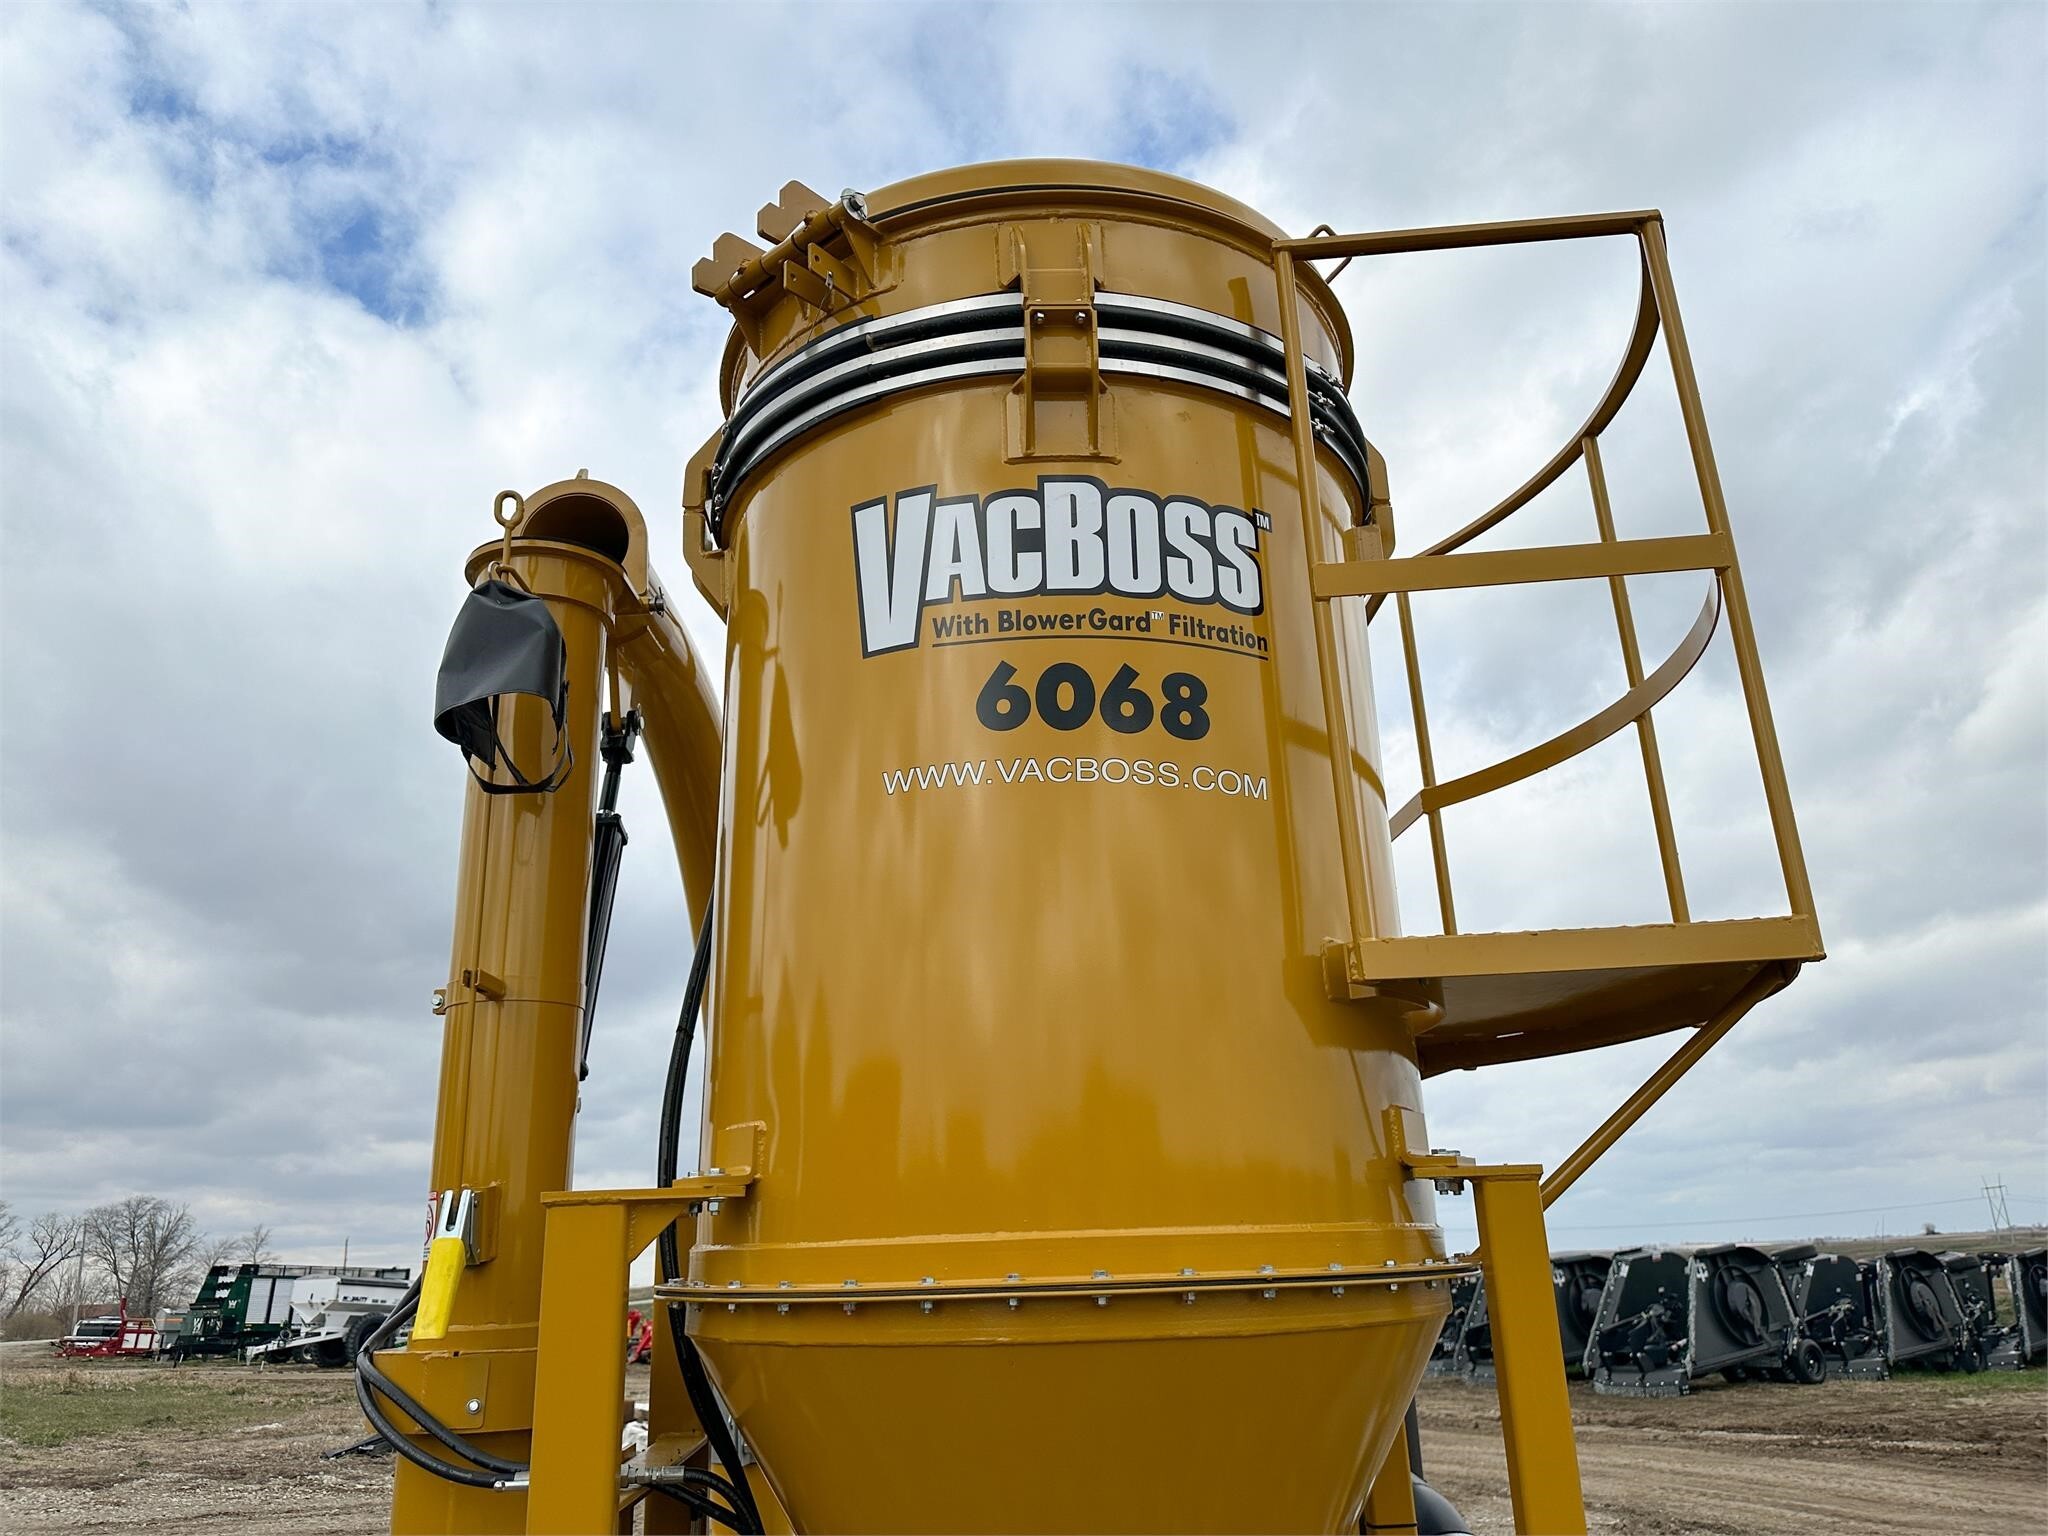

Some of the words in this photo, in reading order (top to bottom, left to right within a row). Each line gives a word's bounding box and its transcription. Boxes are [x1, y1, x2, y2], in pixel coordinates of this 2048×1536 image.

[932, 611, 990, 639] With
[1169, 614, 1269, 652] Filtration
[975, 660, 1211, 741] 6068
[882, 756, 1268, 801] WWW.VACBOSS.COM
